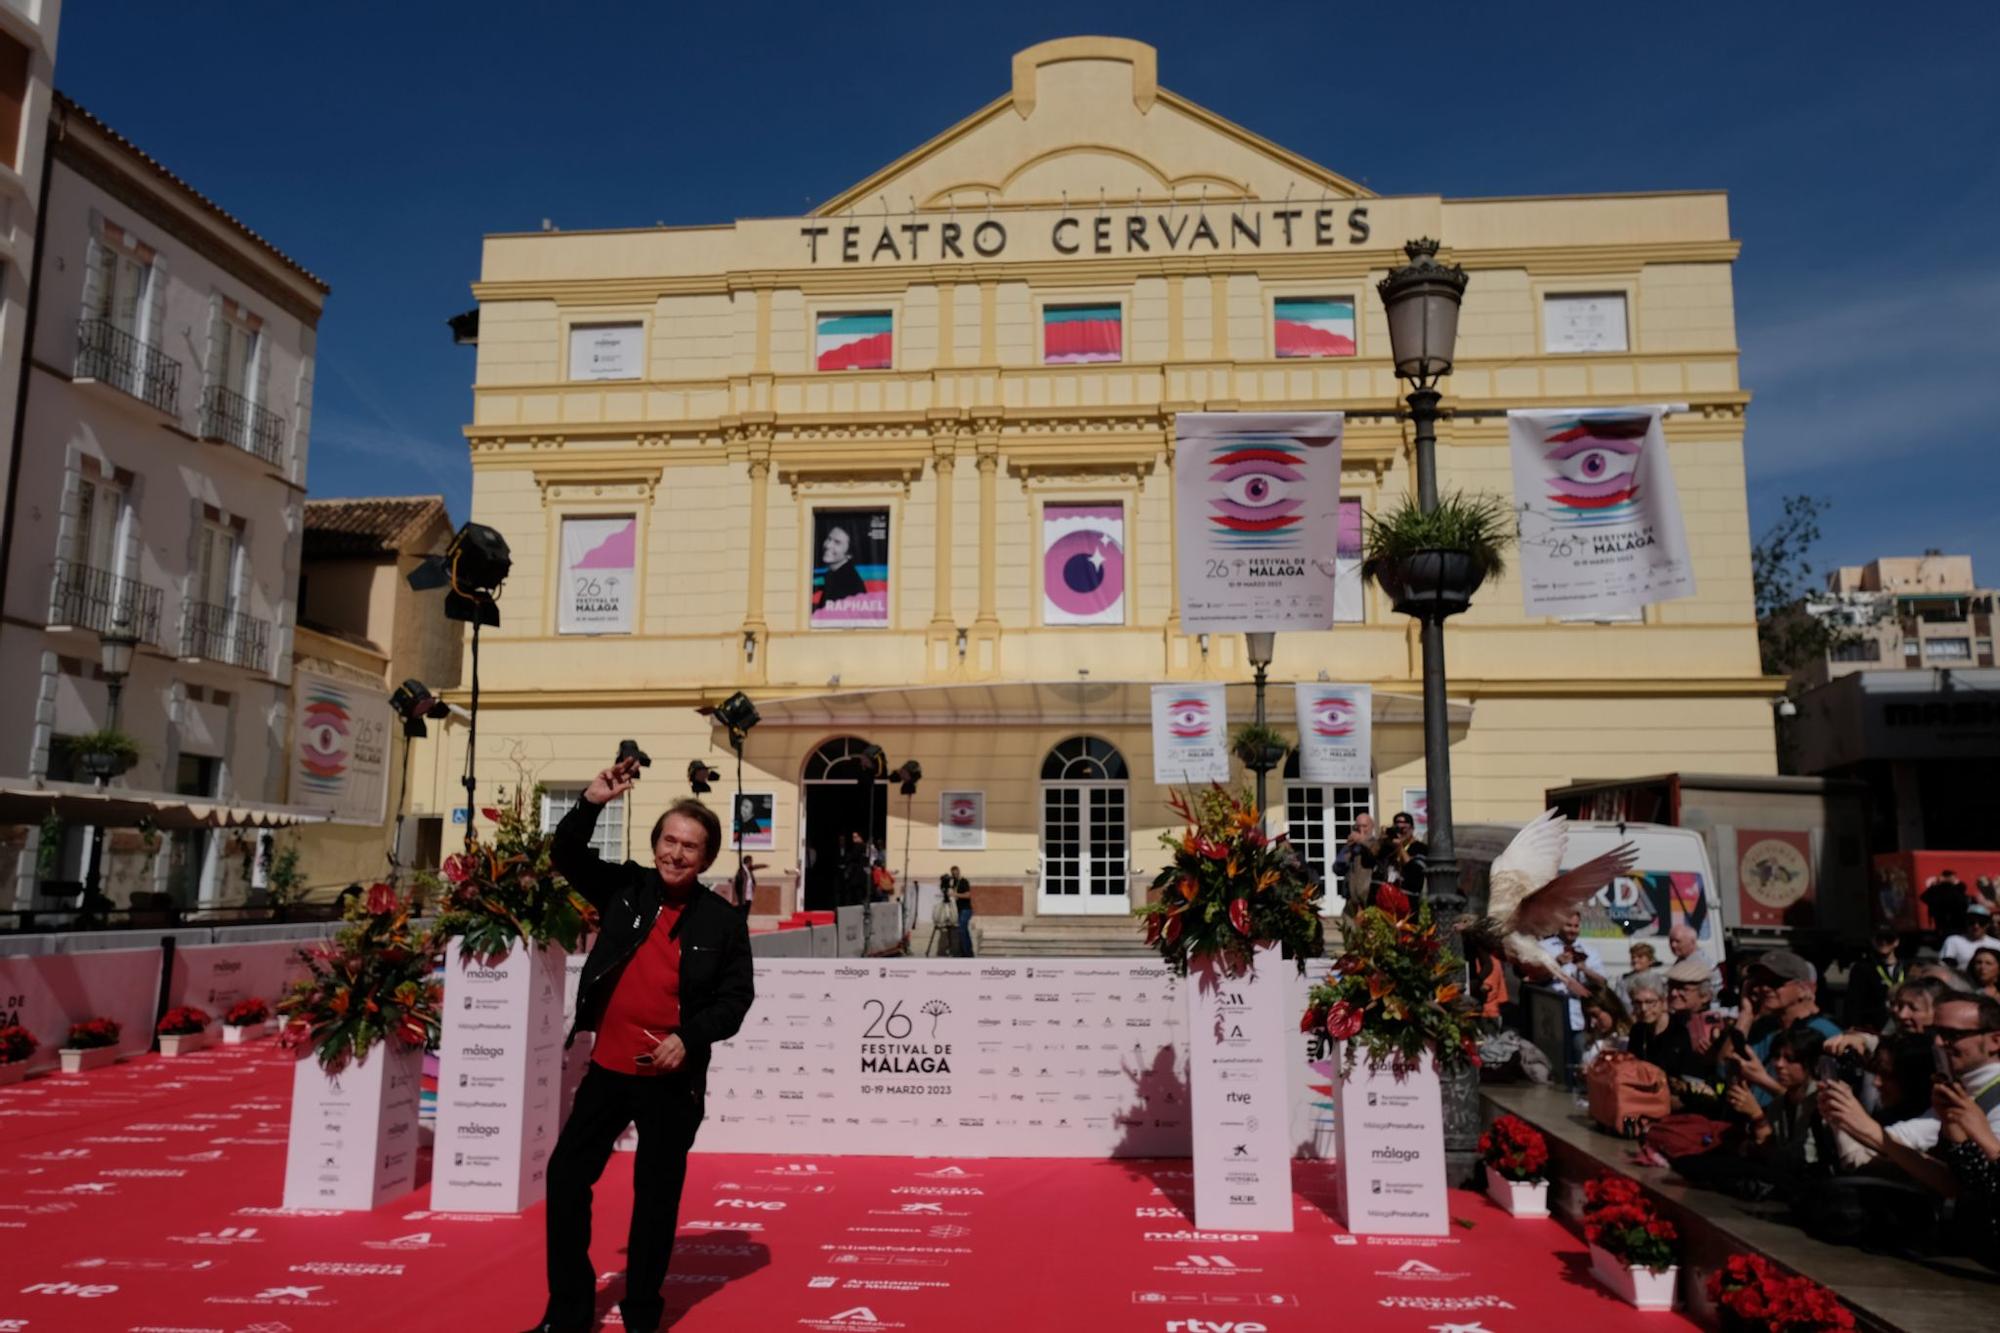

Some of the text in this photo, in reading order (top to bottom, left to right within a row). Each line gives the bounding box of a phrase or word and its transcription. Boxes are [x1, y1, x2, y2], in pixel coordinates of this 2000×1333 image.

[801, 207, 1371, 263] TEATRO CERVANTES
[1549, 538, 1573, 559] 26
[1206, 558, 1230, 577] 26
[1249, 557, 1305, 565] FESTIVAL DE
[576, 577, 601, 597] 26
[825, 598, 886, 612] RAPHAEL
[861, 999, 912, 1039] 26
[861, 1043, 952, 1054] FESTIVAL DE
[860, 1084, 952, 1095] 10-19 MARZO 2023
[1226, 1091, 1252, 1104] rtve
[1371, 1146, 1420, 1162] málaga
[714, 1198, 787, 1210] rtve
[20, 1281, 120, 1298] rtve
[1166, 1317, 1268, 1333] rtve
